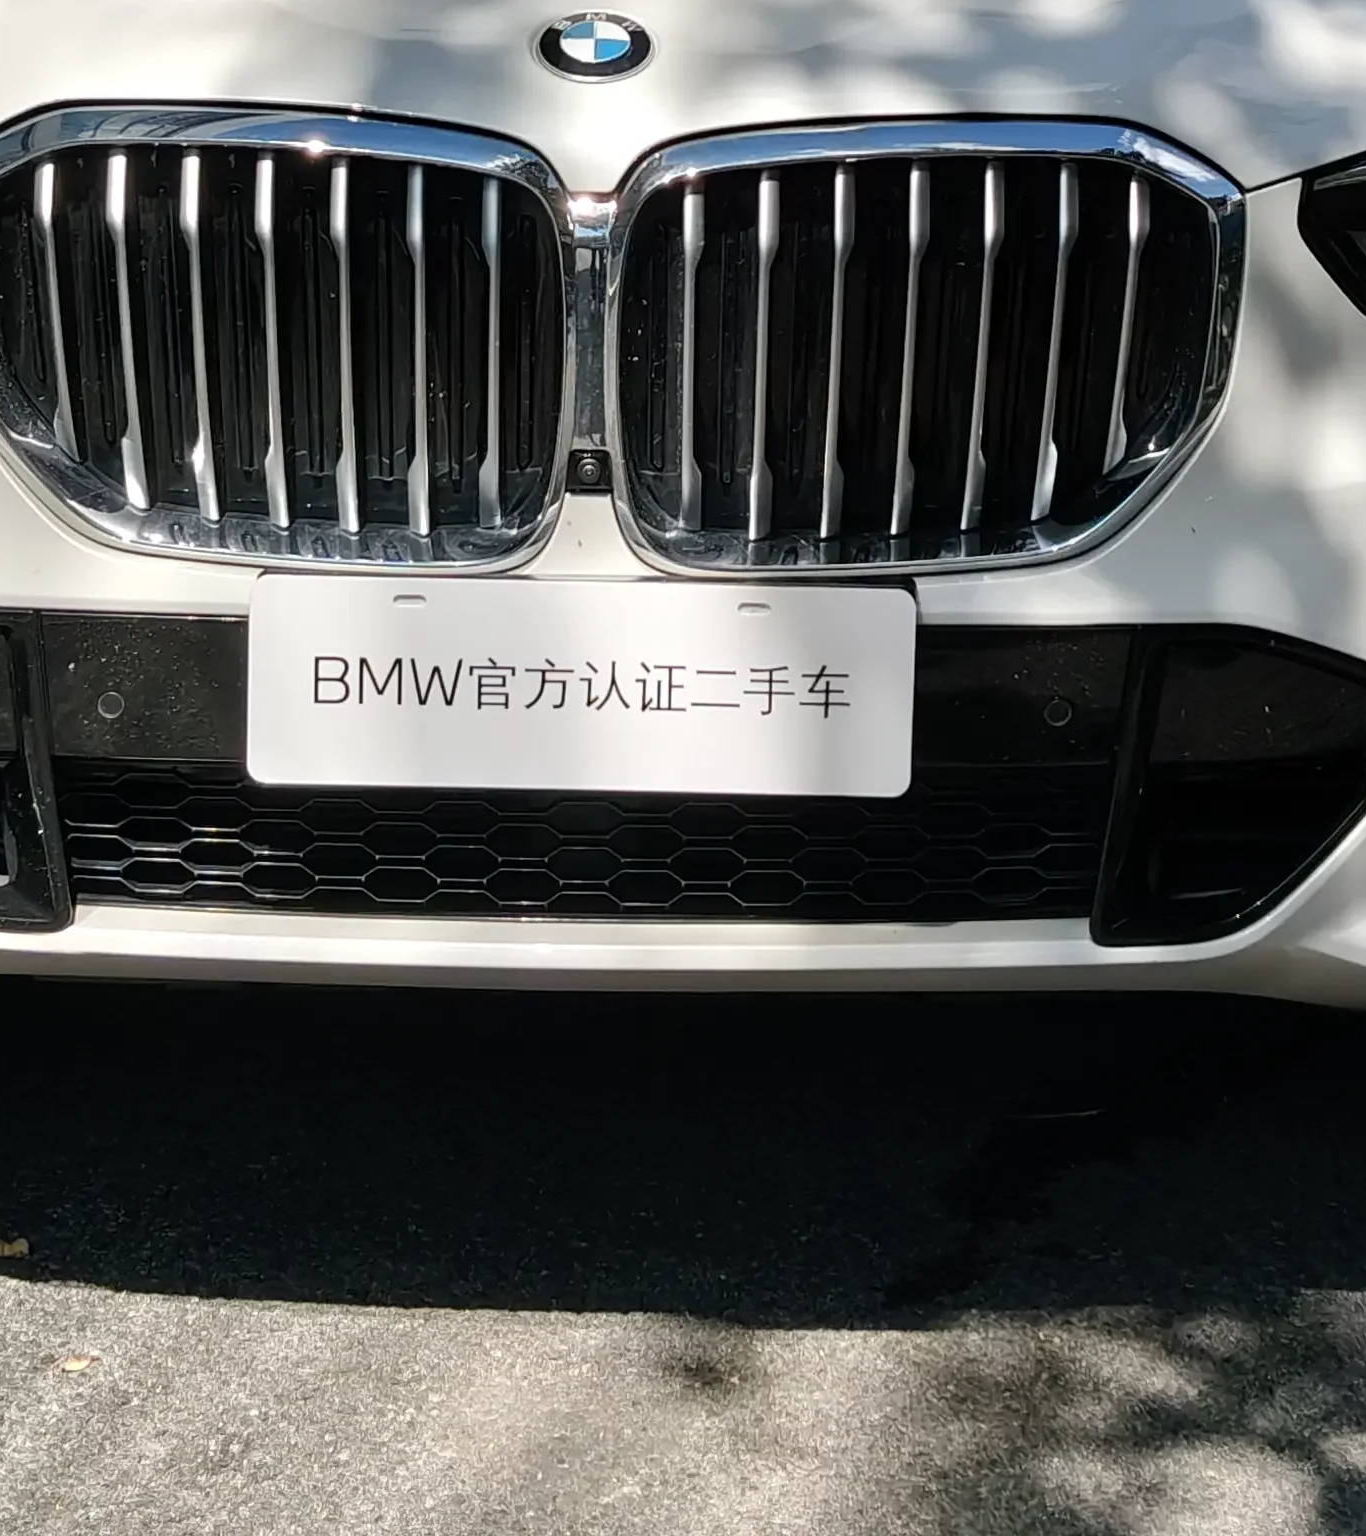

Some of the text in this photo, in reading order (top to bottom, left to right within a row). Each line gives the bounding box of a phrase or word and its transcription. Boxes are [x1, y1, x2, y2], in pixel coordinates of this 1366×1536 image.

[313, 656, 851, 719] BMW官方认证二手车
